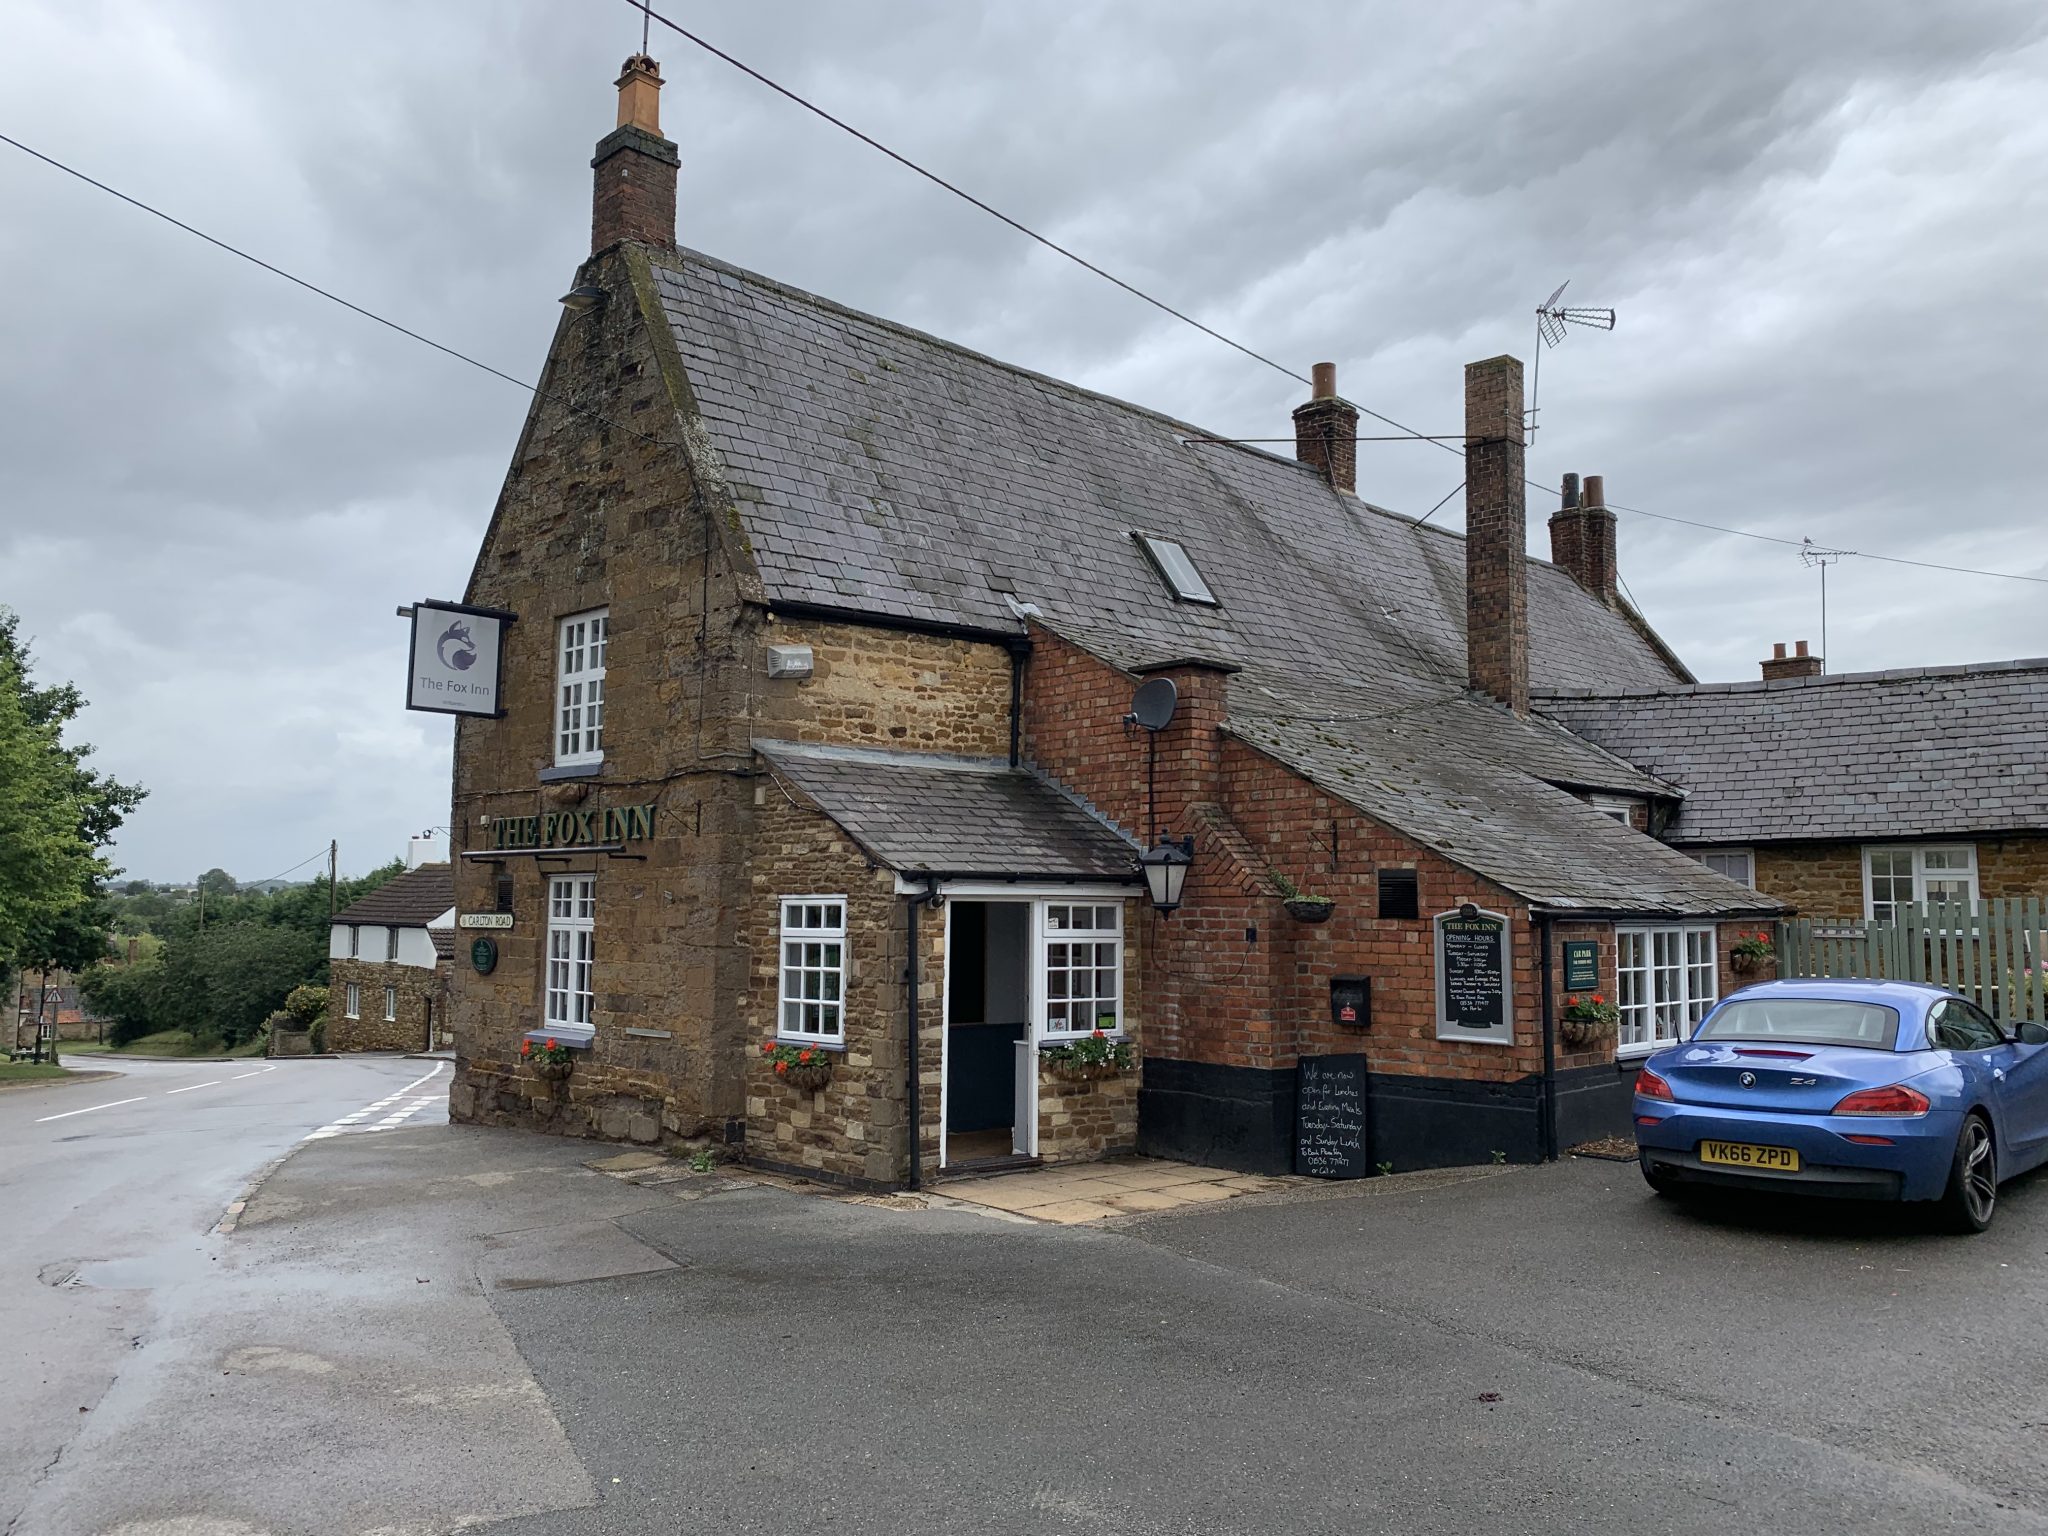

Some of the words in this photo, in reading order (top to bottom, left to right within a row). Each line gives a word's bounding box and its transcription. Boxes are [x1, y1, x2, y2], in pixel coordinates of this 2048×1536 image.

[420, 677, 443, 690] The
[447, 680, 468, 693] Fox
[471, 683, 490, 696] Inn
[493, 816, 539, 849] THE
[542, 811, 595, 846] FOX
[602, 804, 656, 842] INN
[468, 915, 493, 926] CARLTON
[495, 916, 511, 926] ROAD
[1464, 923, 1480, 931] FOX
[1481, 923, 1497, 931] INN
[1445, 933, 1471, 941] OPENING
[1474, 934, 1495, 942] HOURS
[1303, 1063, 1319, 1080] We
[1321, 1071, 1336, 1080] are
[1337, 1071, 1354, 1080] now
[1789, 1077, 1817, 1086] Z4
[1301, 1086, 1321, 1103] open
[1322, 1083, 1331, 1100] for
[1334, 1084, 1359, 1097] Lunches
[1301, 1100, 1317, 1111] and
[1318, 1101, 1341, 1119] Evening
[1341, 1101, 1363, 1116] Meals
[1300, 1134, 1312, 1145] and
[1315, 1134, 1339, 1149] Sunday
[1340, 1136, 1361, 1150] Lunch
[1300, 1147, 1308, 1157] To
[1708, 1143, 1752, 1163] VK66
[1756, 1147, 1791, 1166] ZPD
